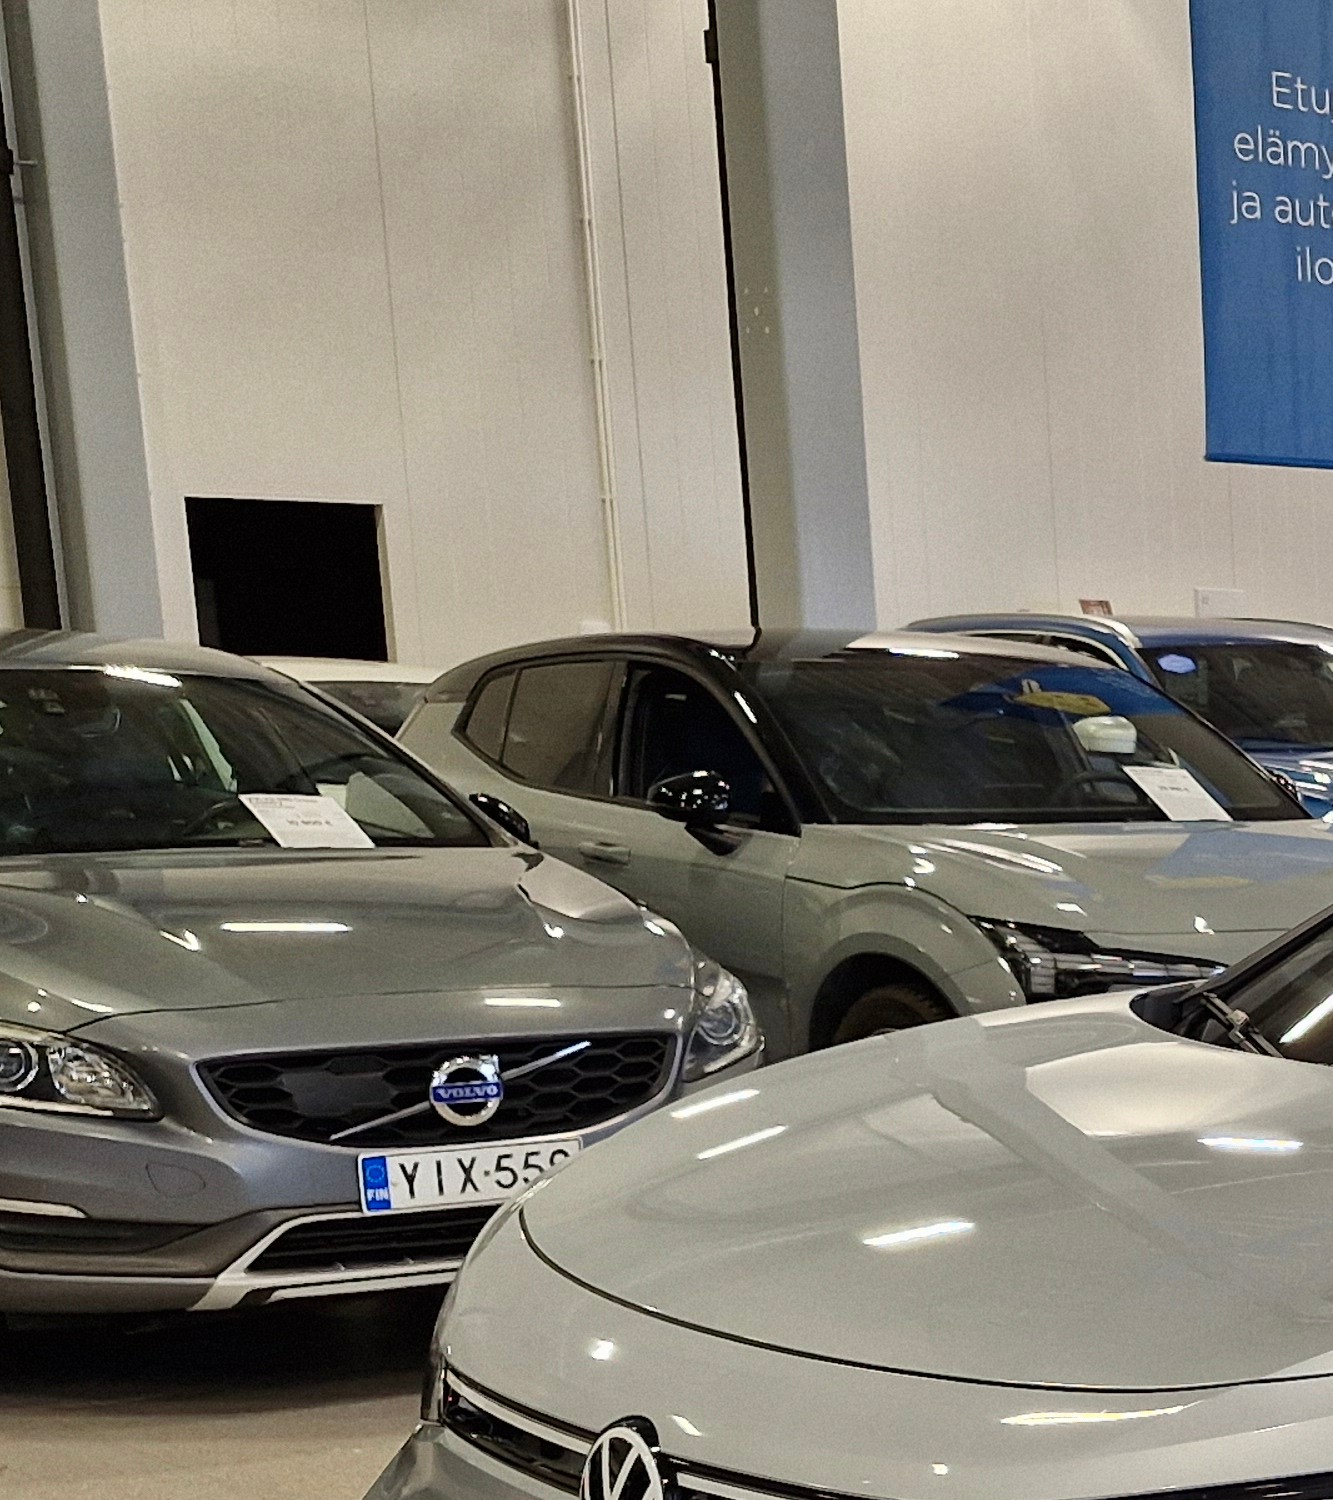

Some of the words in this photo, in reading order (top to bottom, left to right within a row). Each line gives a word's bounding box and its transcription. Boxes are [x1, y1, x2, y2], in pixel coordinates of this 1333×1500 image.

[1230, 179, 1262, 225] ja
[435, 1083, 499, 1100] VOLVO
[366, 1187, 391, 1202] FIN
